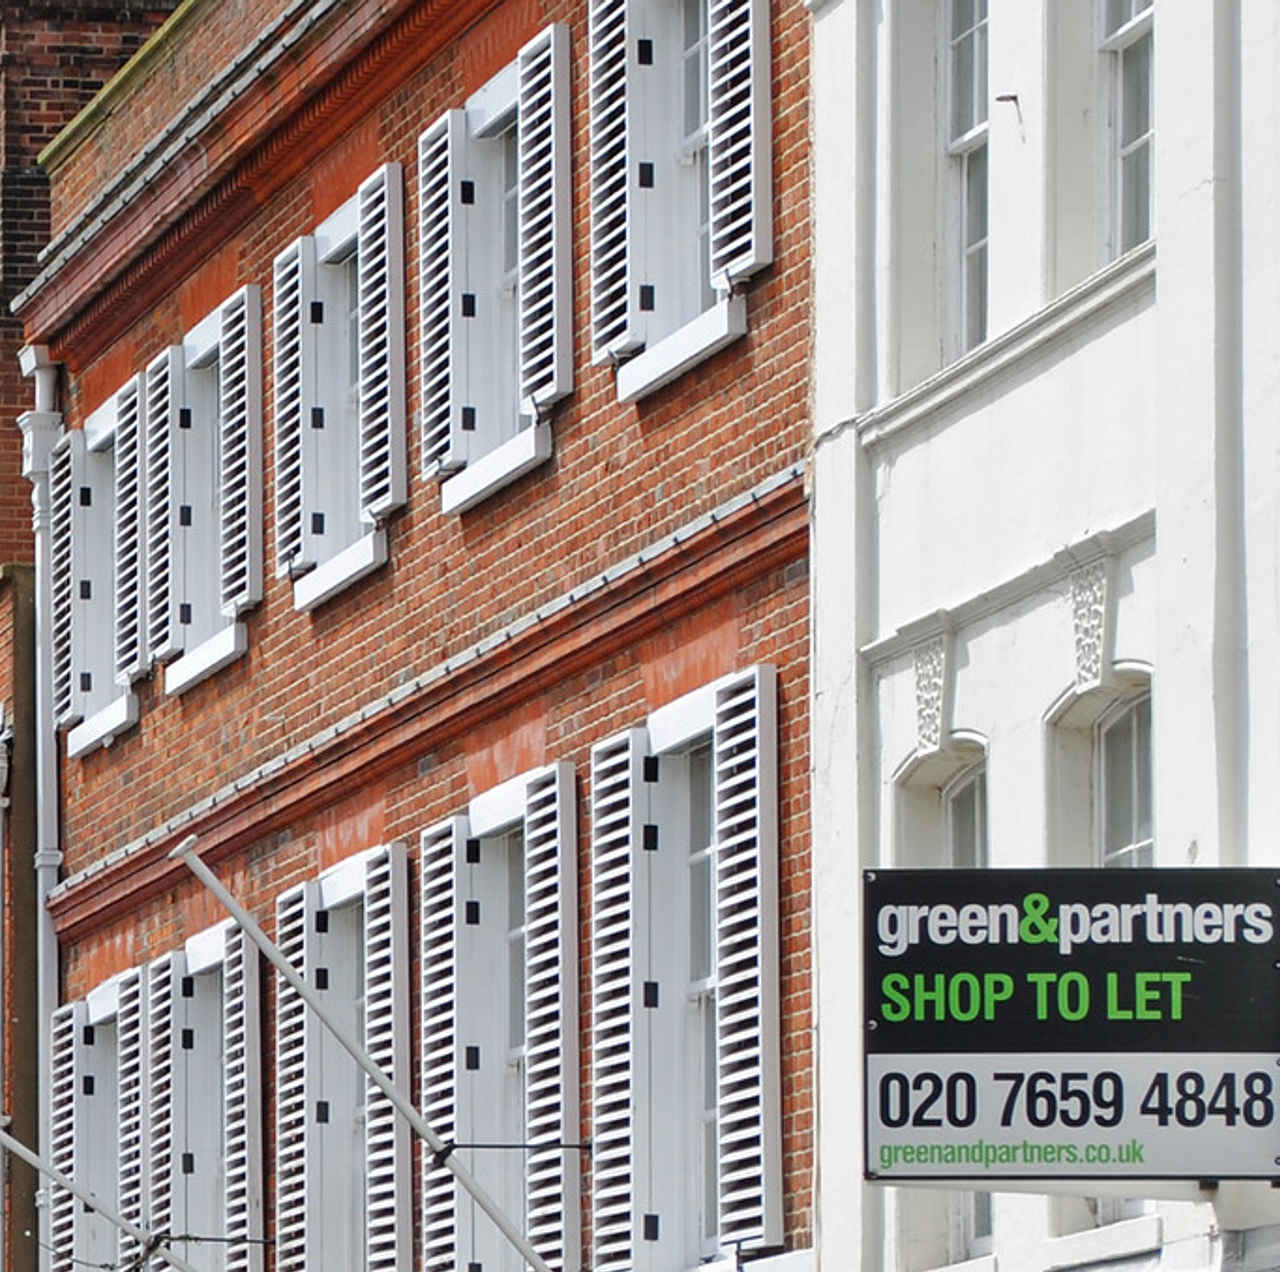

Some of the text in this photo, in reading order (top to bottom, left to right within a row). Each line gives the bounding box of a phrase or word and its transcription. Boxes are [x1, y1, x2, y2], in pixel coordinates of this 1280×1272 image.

[877, 893, 1274, 956] green&partners
[881, 972, 1192, 1021] SHOP TO LET
[879, 1071, 1275, 1128] 020 7659 4848
[880, 1138, 1145, 1169] greenandpartners.co.uk
